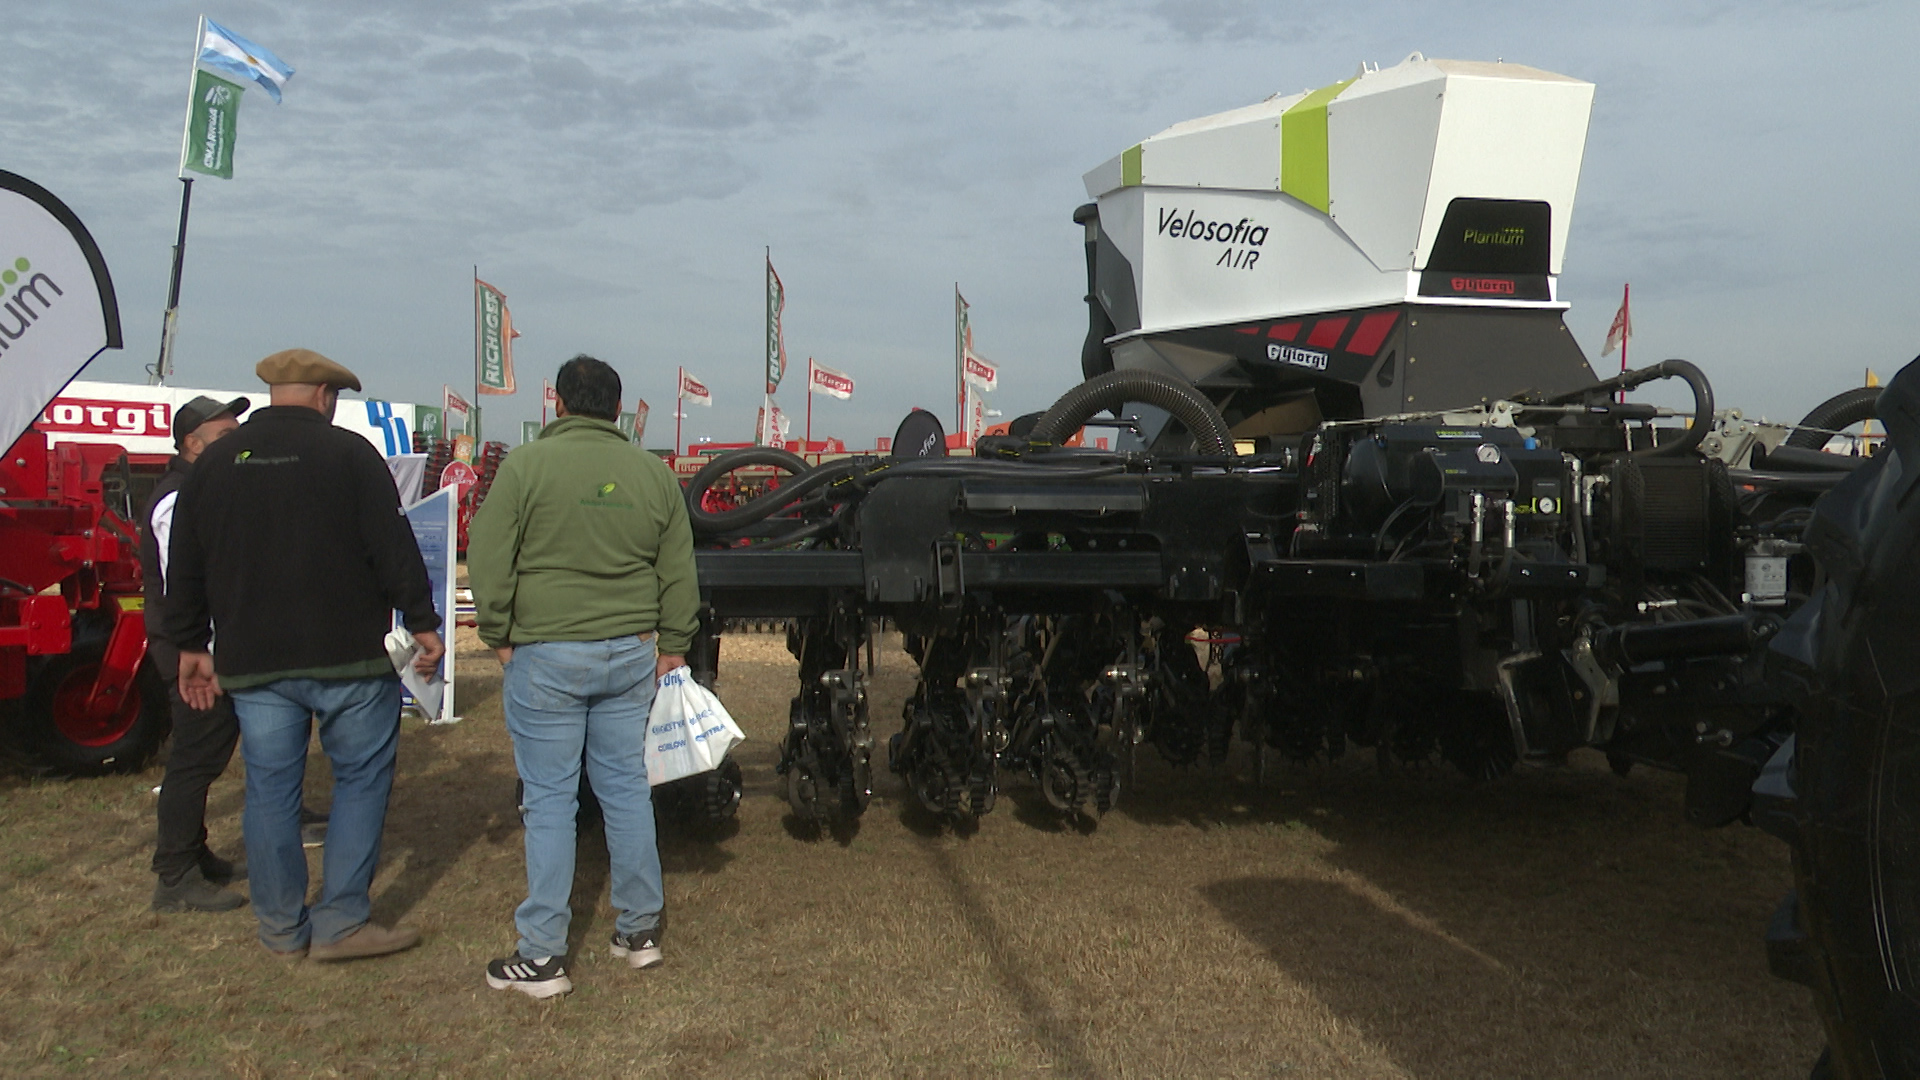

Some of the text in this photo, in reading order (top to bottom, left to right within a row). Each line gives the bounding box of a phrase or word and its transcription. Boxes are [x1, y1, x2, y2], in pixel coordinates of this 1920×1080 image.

[1158, 207, 1269, 246] Velosofia
[1463, 228, 1525, 245] Plantium
[1216, 247, 1260, 270] AIR
[485, 290, 501, 384] RICHIGER
